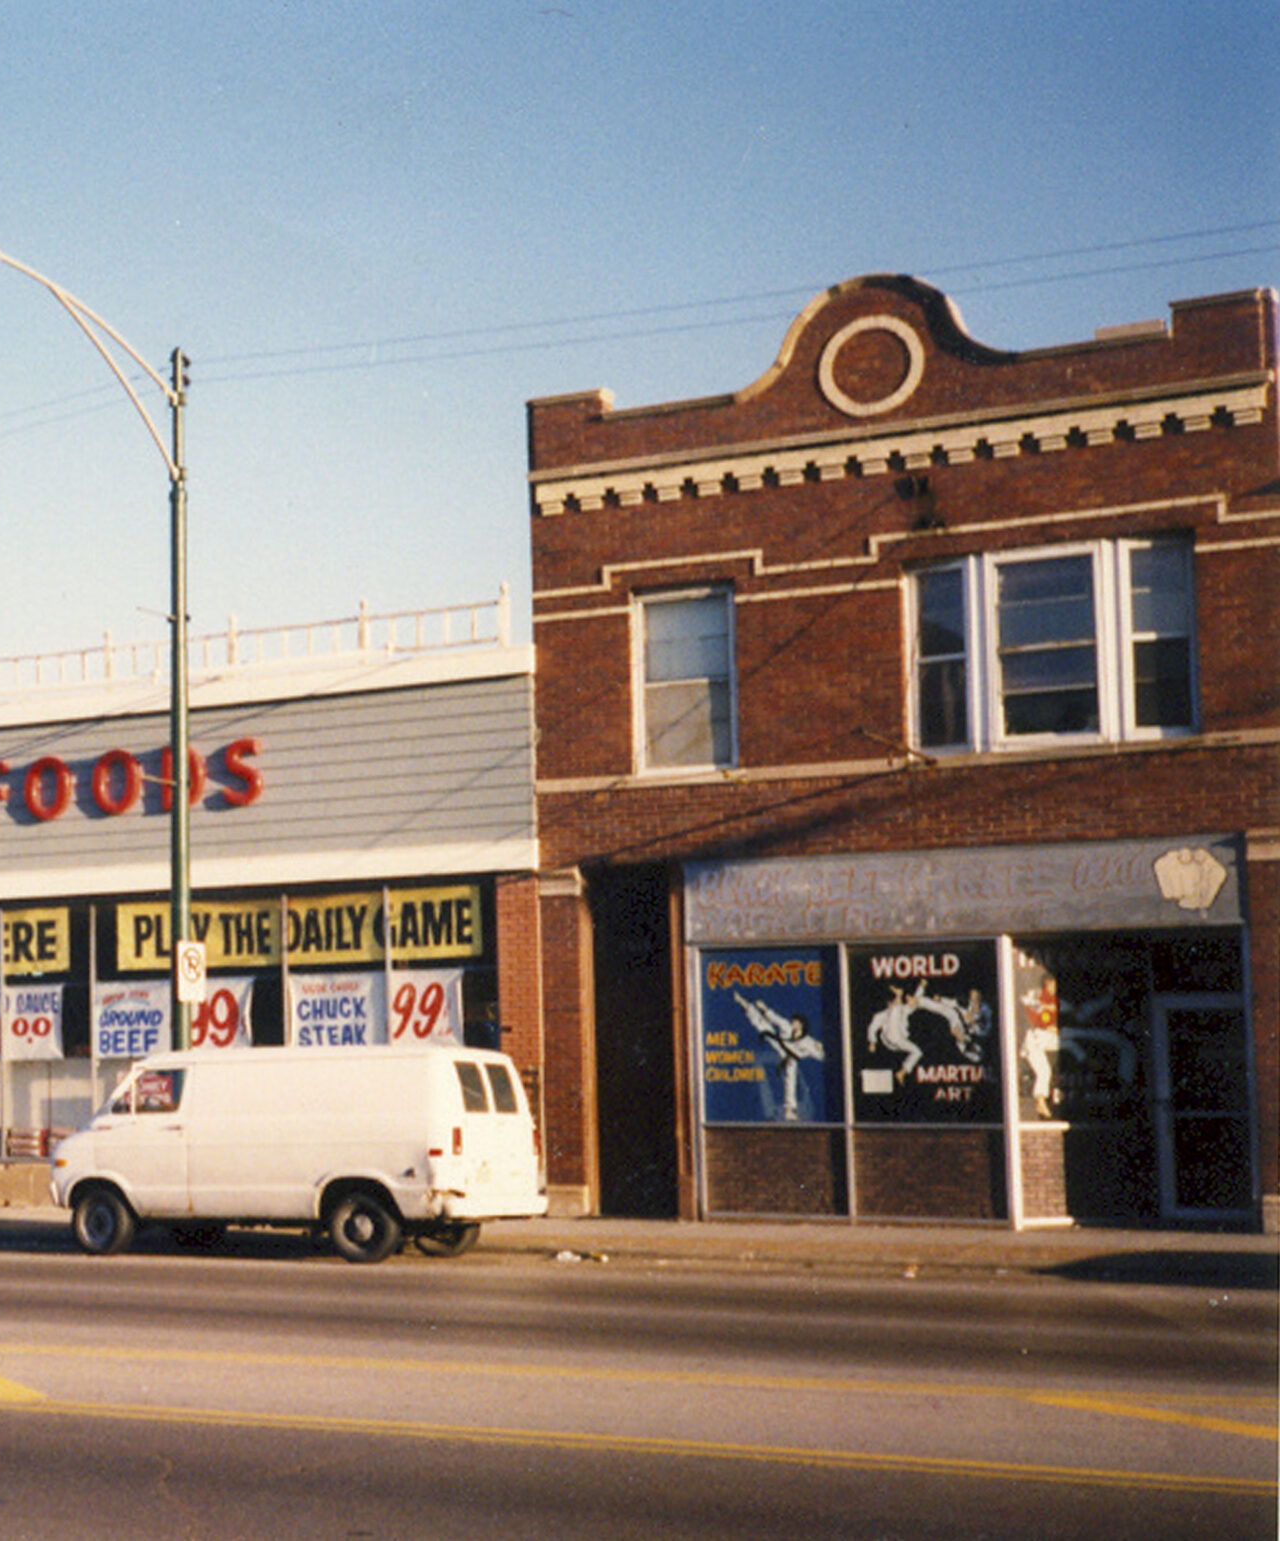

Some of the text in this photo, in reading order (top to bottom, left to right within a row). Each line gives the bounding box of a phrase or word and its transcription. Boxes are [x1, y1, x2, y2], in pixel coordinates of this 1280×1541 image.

[134, 899, 473, 957] PLY THE DAILY GAME
[706, 961, 823, 990] KARATE
[871, 954, 961, 979] WORLD
[99, 1008, 163, 1027] GROUND
[297, 996, 366, 1021] CHUCK
[392, 981, 445, 1039] 99
[99, 1029, 159, 1053] BEEF
[298, 1024, 367, 1046] STEAK
[705, 1031, 738, 1047] MEN
[704, 1050, 754, 1065] WOMEN
[705, 1067, 765, 1082] CHILDREN
[934, 1085, 972, 1101] ART
